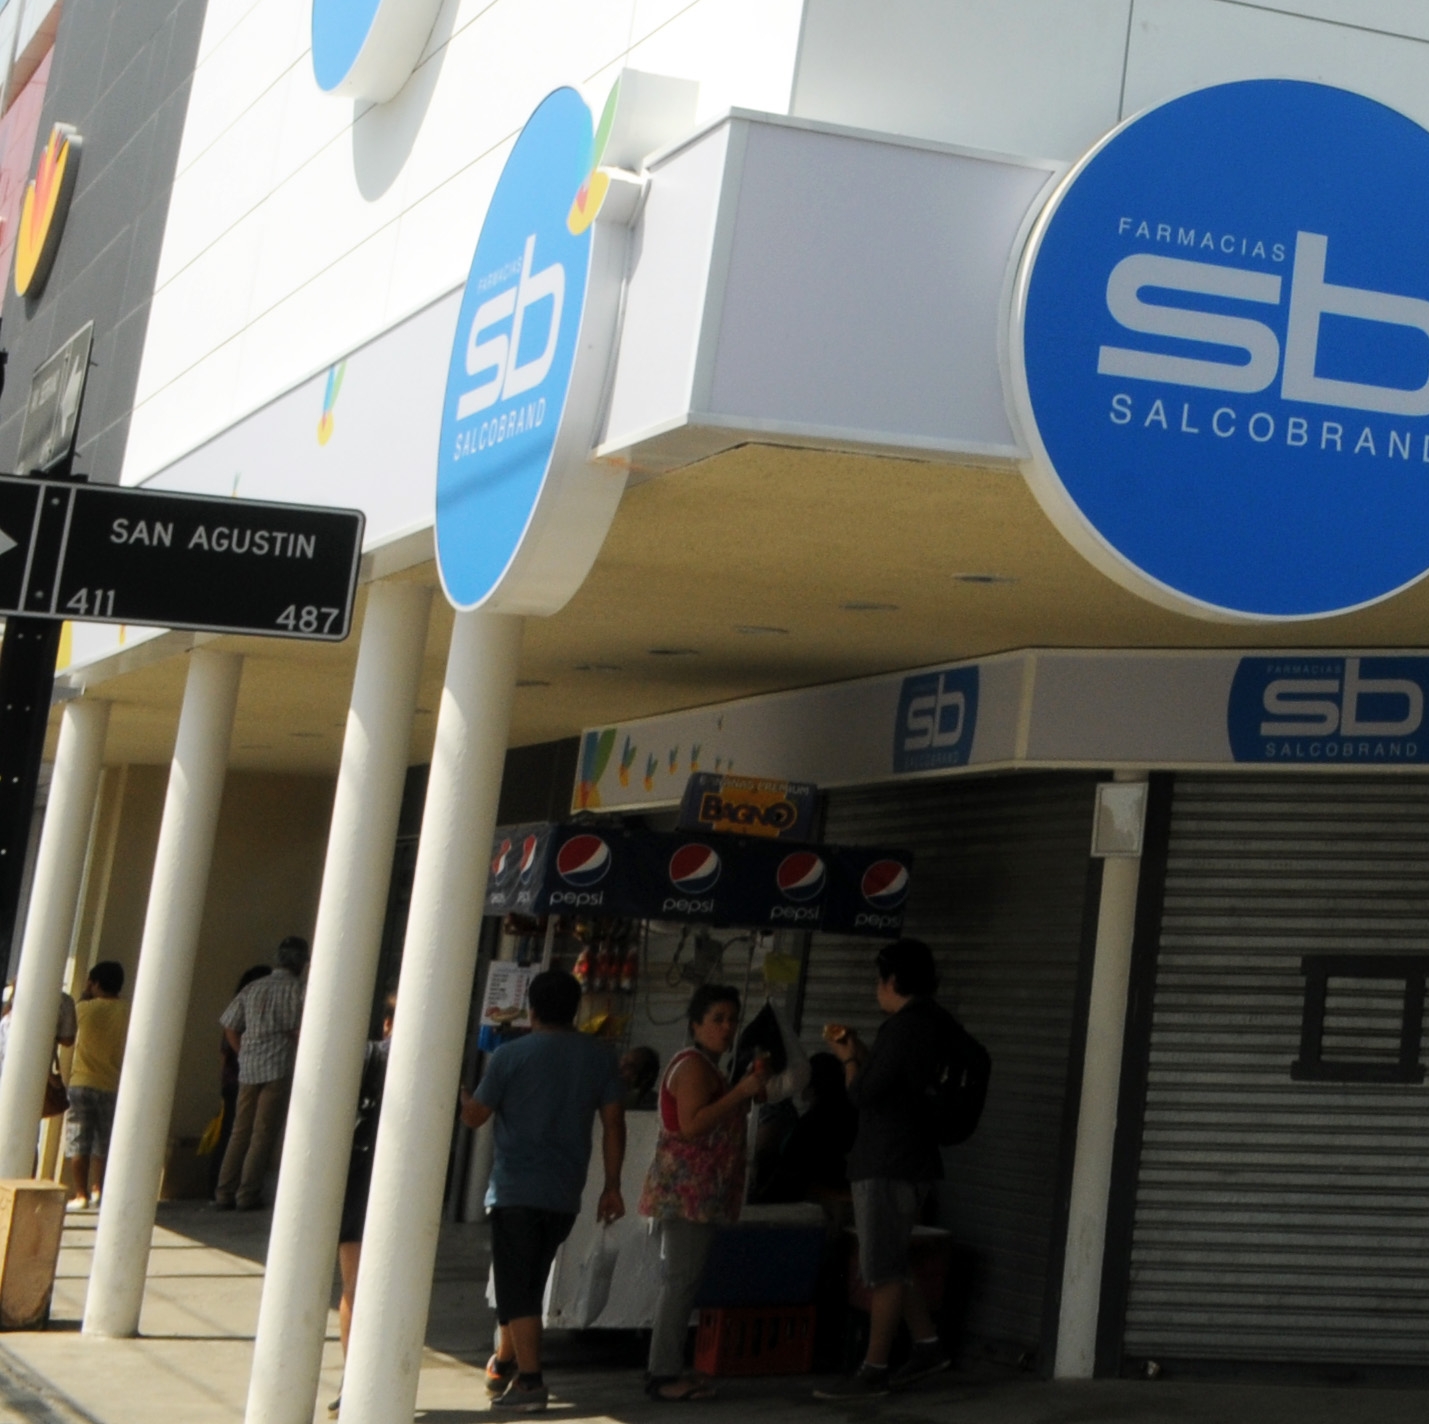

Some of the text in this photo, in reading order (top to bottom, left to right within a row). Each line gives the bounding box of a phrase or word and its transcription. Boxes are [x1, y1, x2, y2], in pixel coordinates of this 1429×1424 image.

[1118, 216, 1286, 262] FARMACIAS
[456, 233, 566, 422] sb
[453, 397, 547, 462] SALCOBRAND
[110, 518, 316, 559] SAN AGUSTIN
[67, 588, 115, 616] 411
[276, 605, 340, 634] 487
[1259, 658, 1424, 737] sb
[904, 673, 965, 752] sb
[1265, 742, 1418, 758] SALCOBRAND
[550, 890, 604, 907] pepsi
[662, 898, 714, 914] pepsi
[770, 904, 820, 921] pepsi
[855, 911, 900, 928] peps
